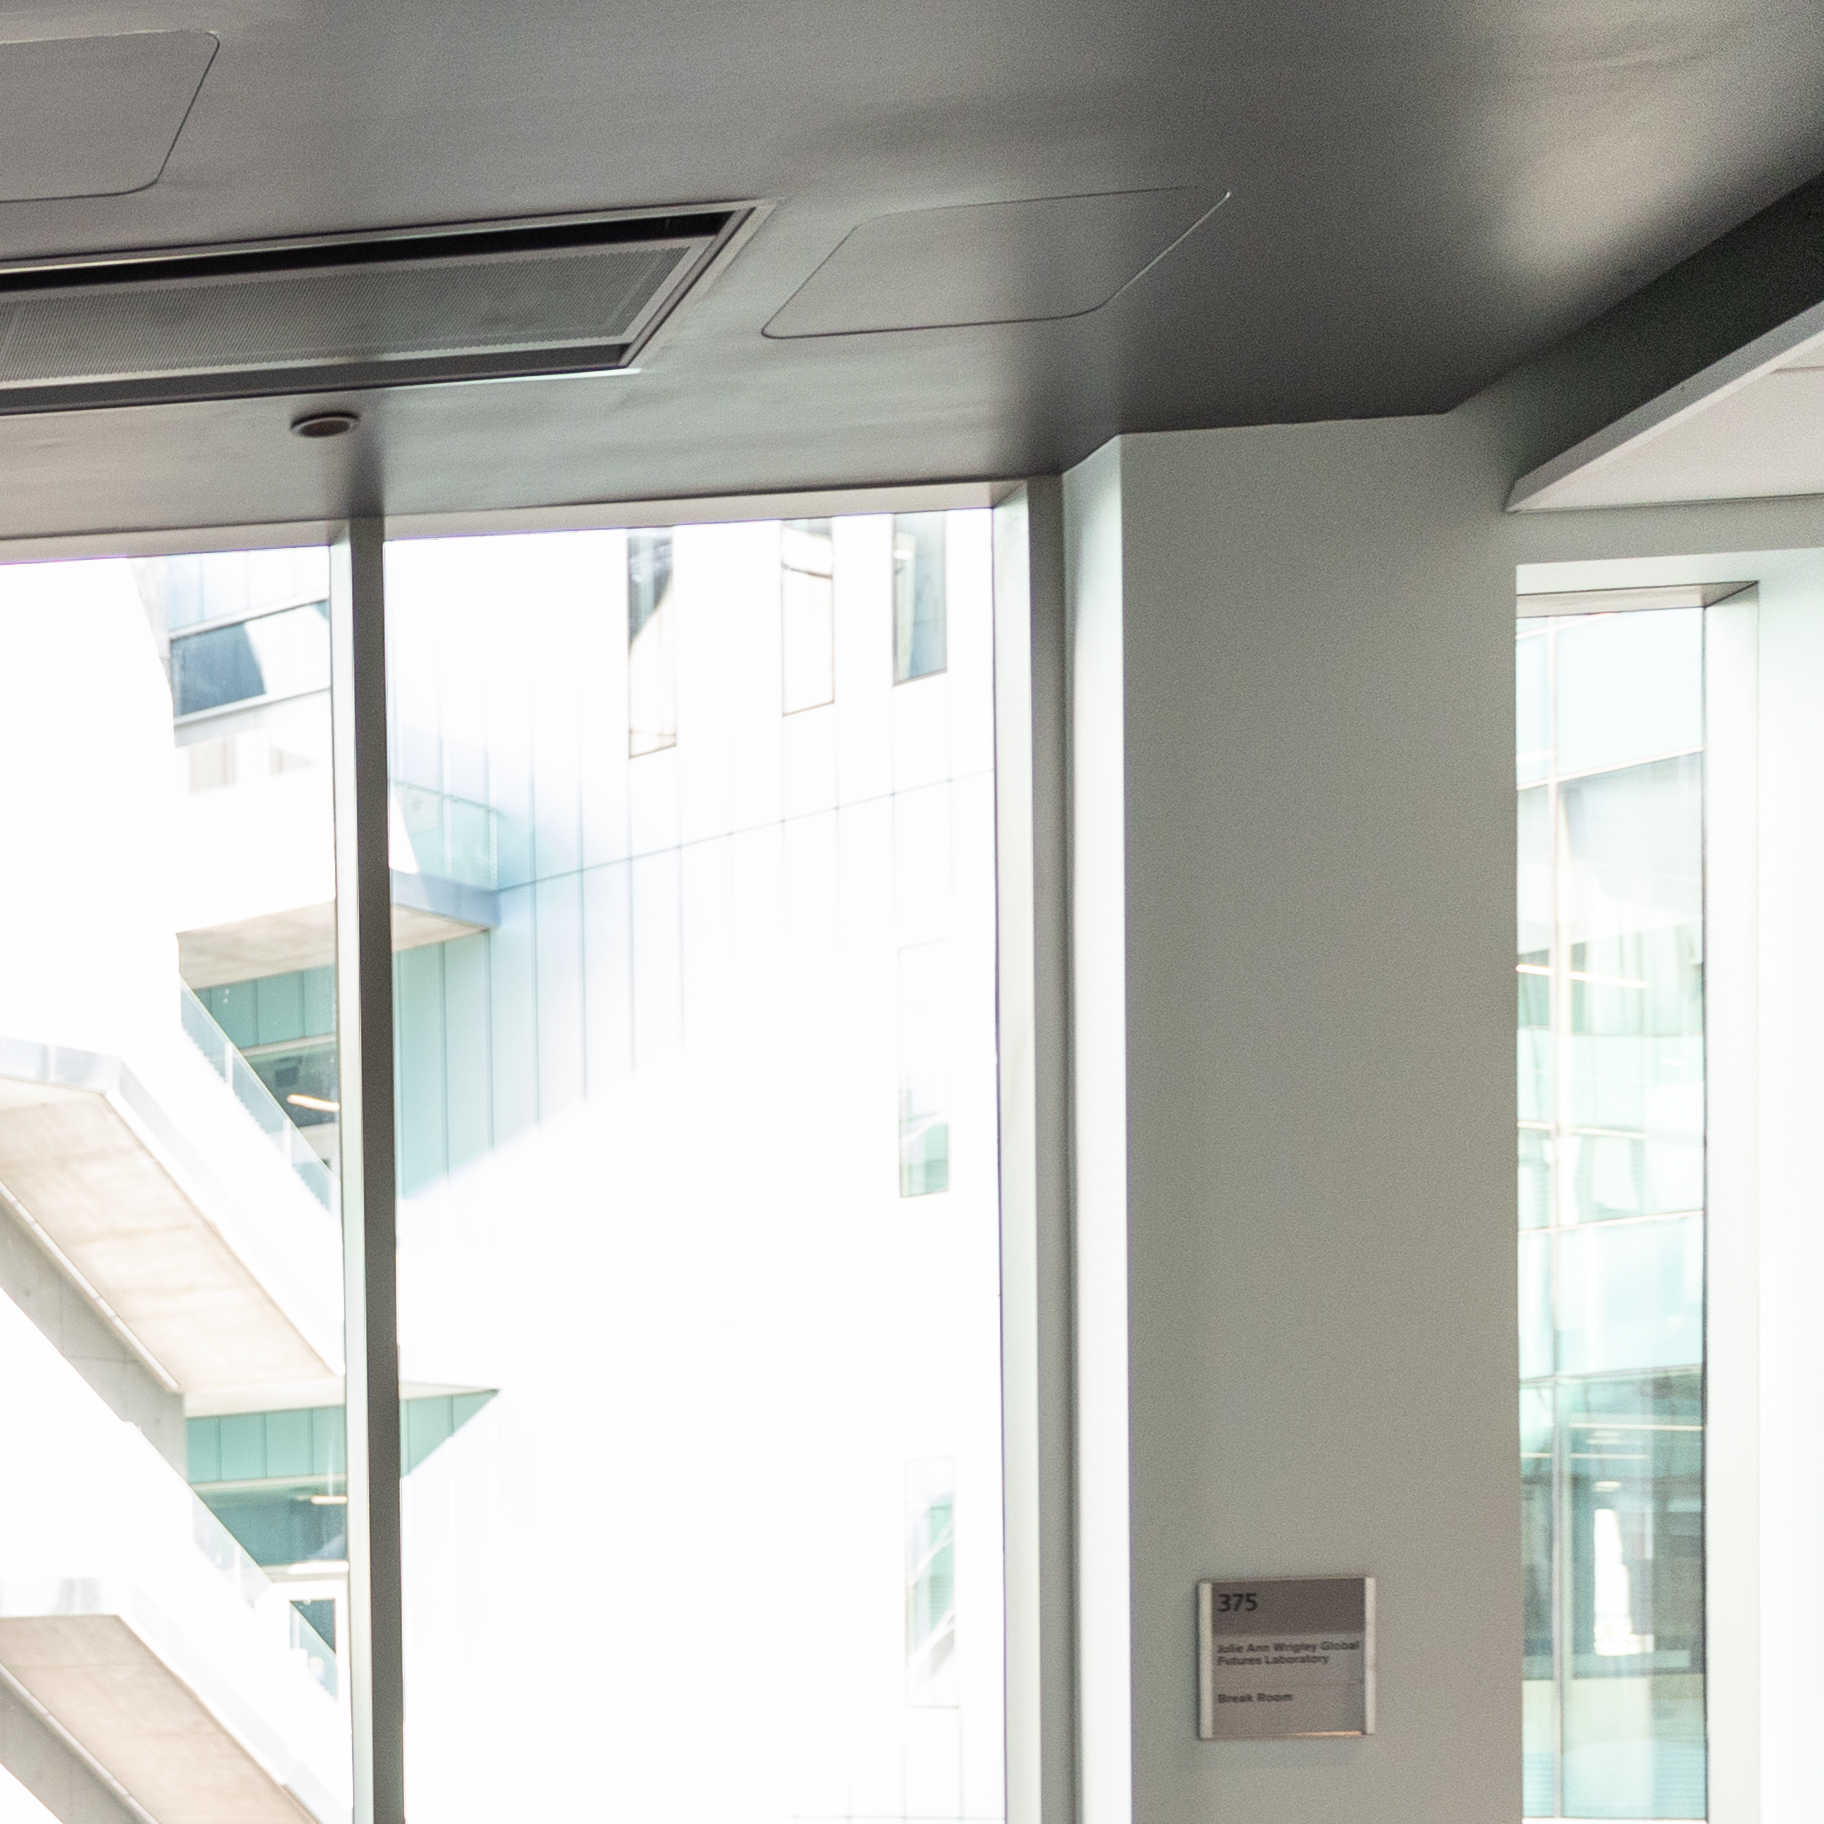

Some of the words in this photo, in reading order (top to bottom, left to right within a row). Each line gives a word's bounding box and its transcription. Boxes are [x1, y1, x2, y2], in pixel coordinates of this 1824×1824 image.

[1218, 1593, 1258, 1612] 375
[1217, 1645, 1243, 1654] Julie
[1247, 1643, 1270, 1652] Ann
[1273, 1643, 1318, 1653] Wrigley
[1320, 1641, 1360, 1651] Global
[1217, 1656, 1262, 1665] Futures
[1264, 1654, 1329, 1665] Laboratory
[1217, 1694, 1254, 1703] Break
[1256, 1692, 1294, 1702] Room
